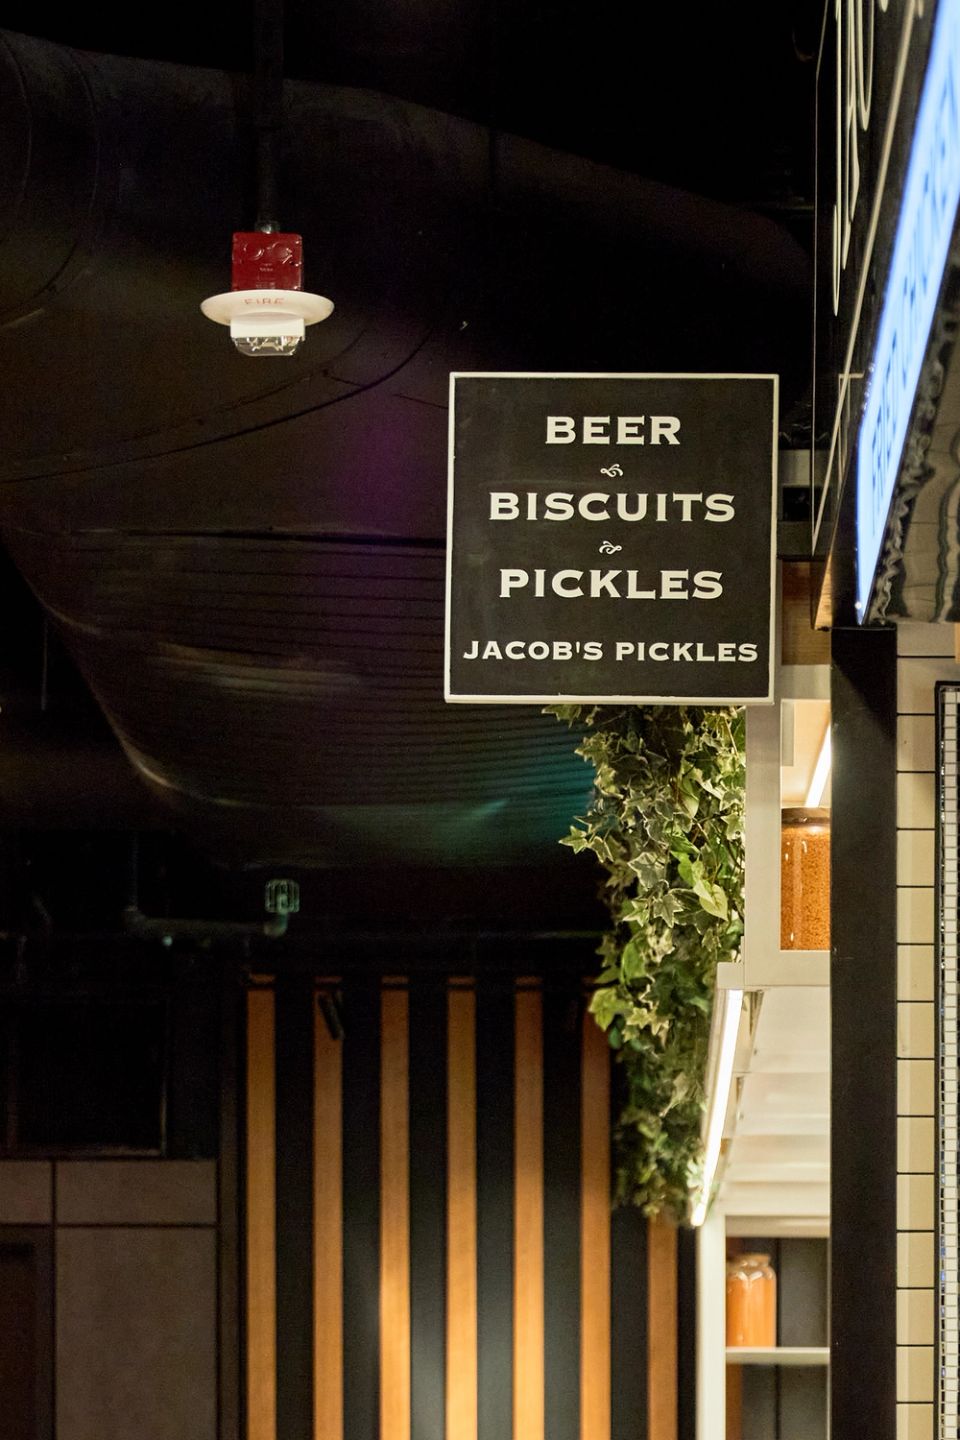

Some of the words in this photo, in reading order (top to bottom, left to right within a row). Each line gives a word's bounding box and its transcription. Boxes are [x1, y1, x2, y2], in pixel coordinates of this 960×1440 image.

[545, 416, 681, 446] BEER
[489, 492, 735, 522] BISCUITS
[499, 569, 724, 600] PICKLES
[463, 640, 603, 661] JACOB'S
[615, 642, 758, 662] PICKLES
